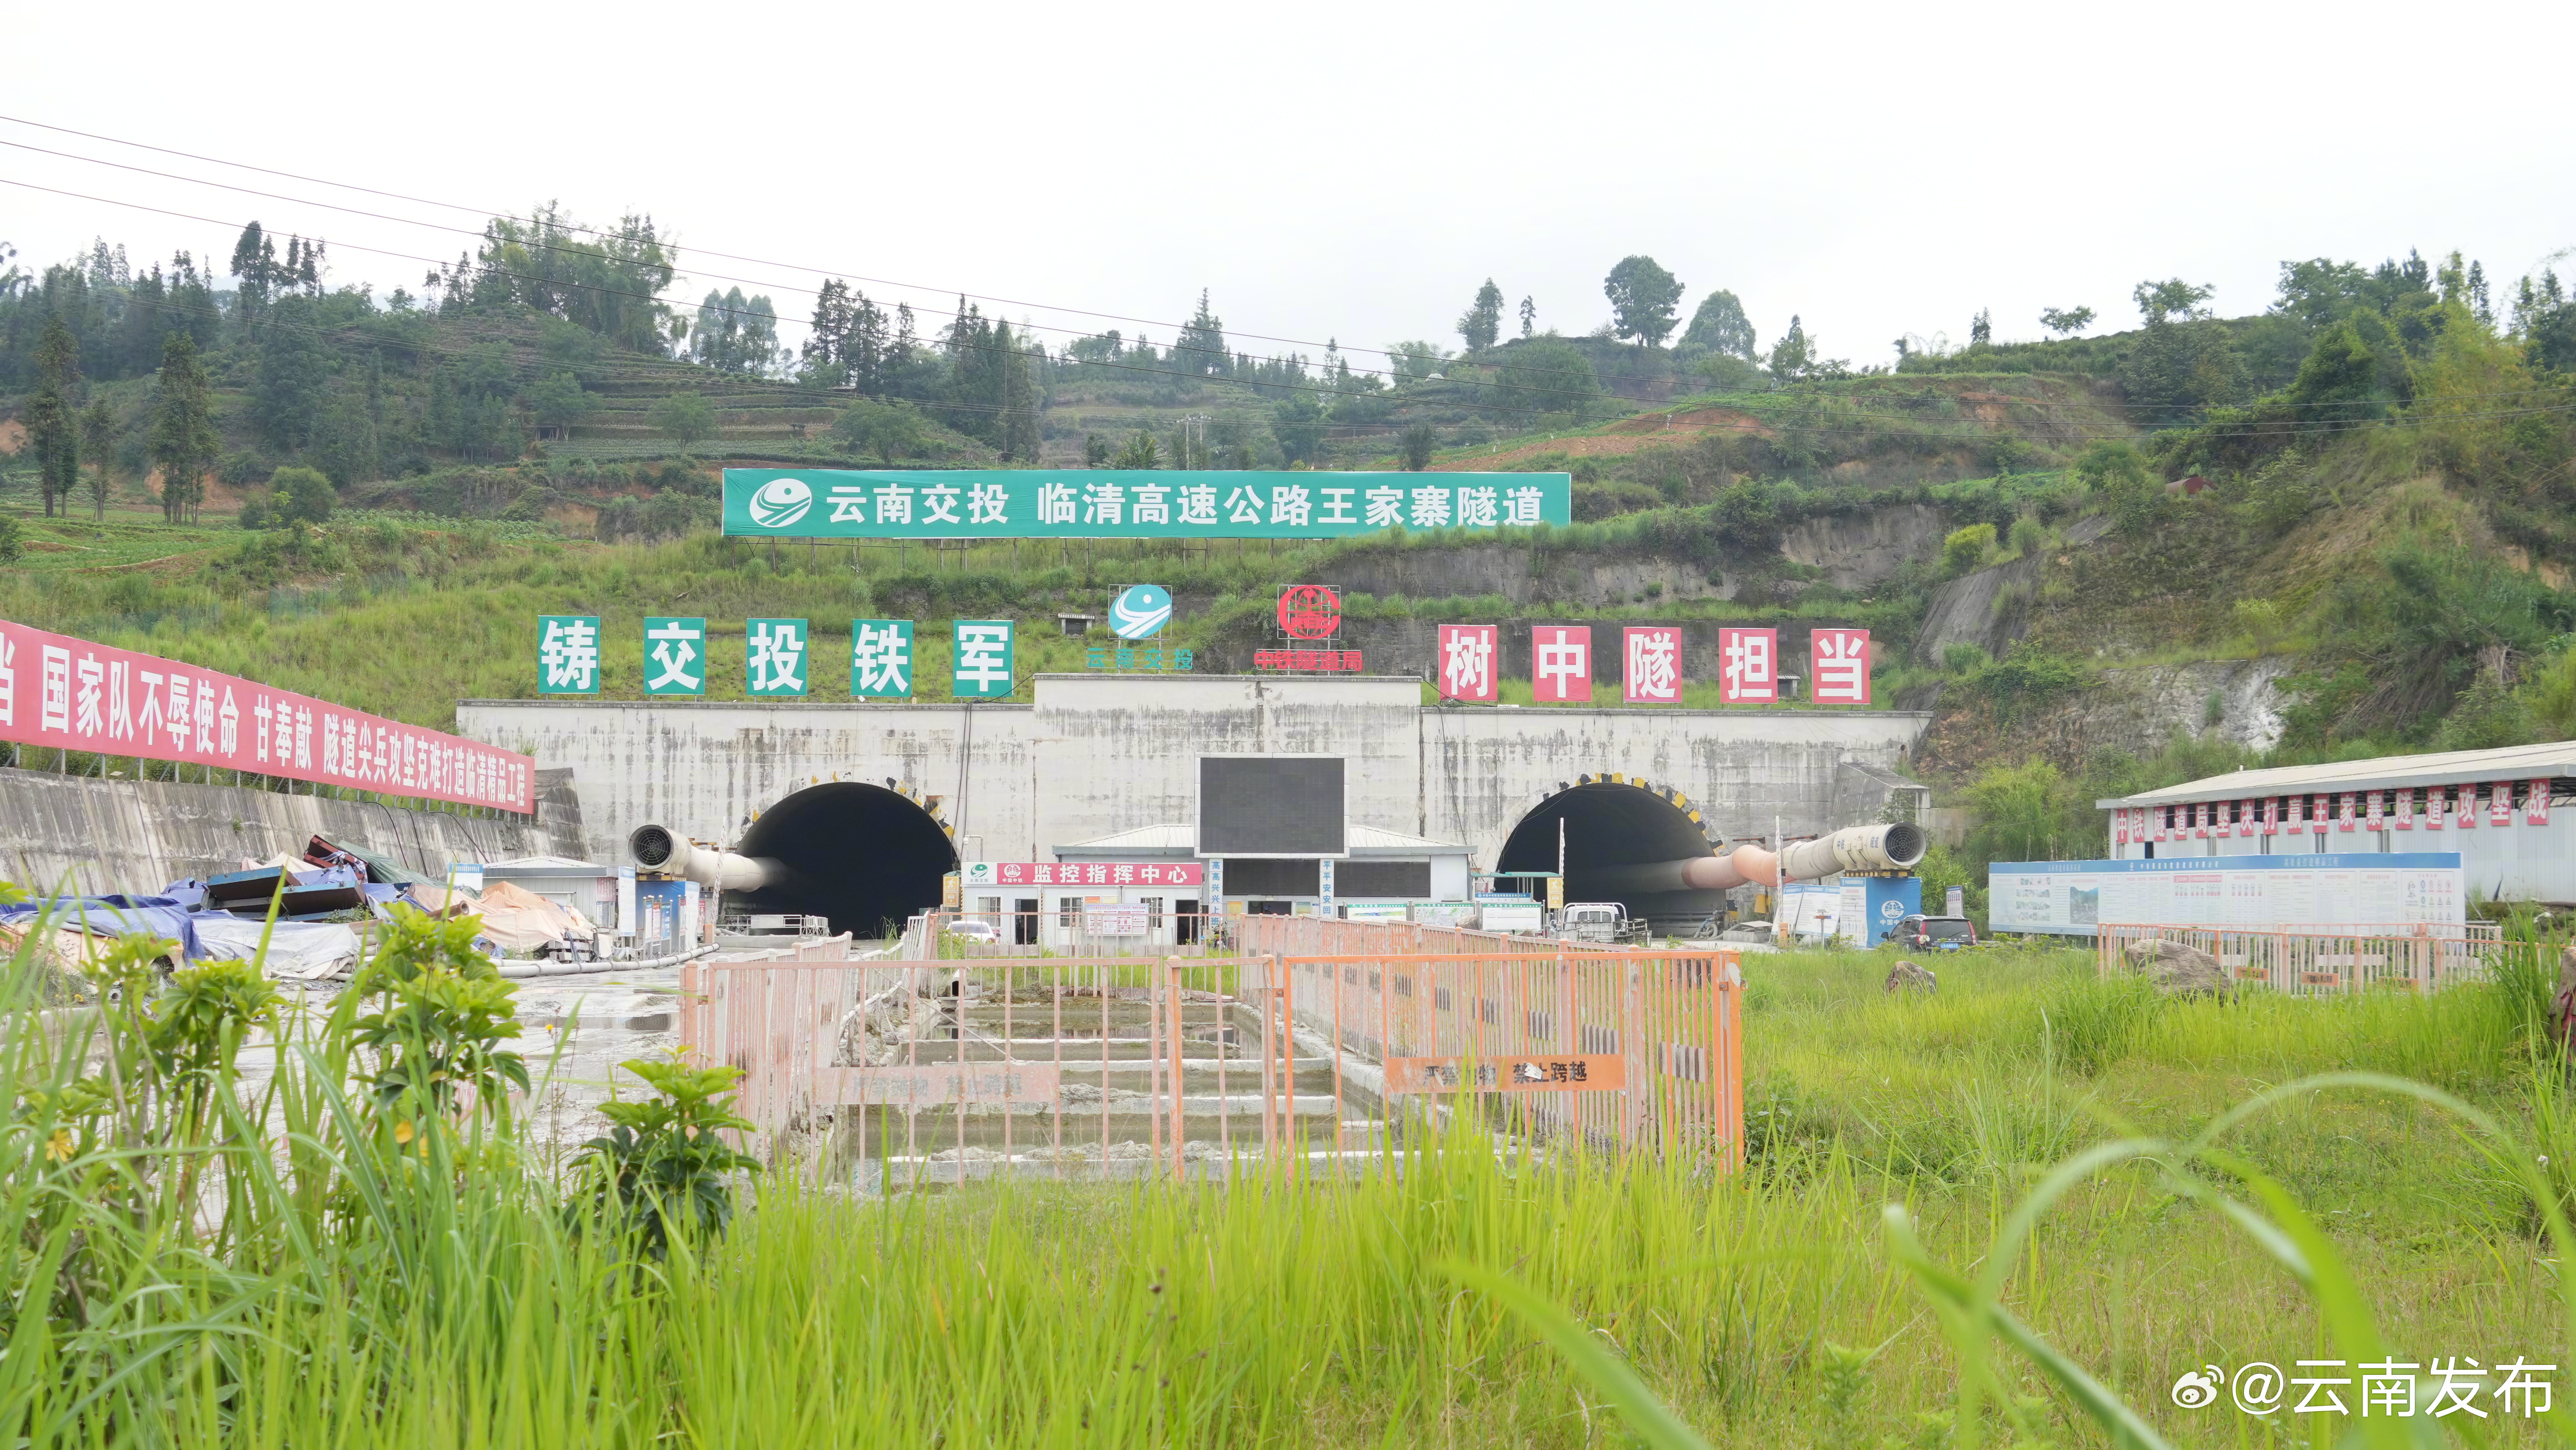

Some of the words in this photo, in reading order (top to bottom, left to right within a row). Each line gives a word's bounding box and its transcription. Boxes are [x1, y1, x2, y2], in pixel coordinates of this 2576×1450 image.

[826, 482, 1010, 525] 云南交投
[1037, 483, 1544, 527] 临清高速公路王家寨隧道
[540, 620, 1009, 692] 铸交投铁军
[1087, 647, 1192, 670] 云南交投
[1254, 650, 1362, 671] 中铁隧道局
[1445, 629, 1863, 701] 树中隧担当
[42, 644, 239, 758] 国家队不辱使命
[254, 694, 312, 771] 甘奉献
[324, 713, 525, 807] 隧道尖兵攻坚克难打造临清精品工程
[2117, 782, 2547, 838] 中铁隧道局坚决打赢王家寨隧道攻坚战
[1032, 864, 1188, 884] 监控指挥中心
[1211, 861, 1220, 926] 高高兴兴上班
[1323, 861, 1331, 915] 平平安安回
